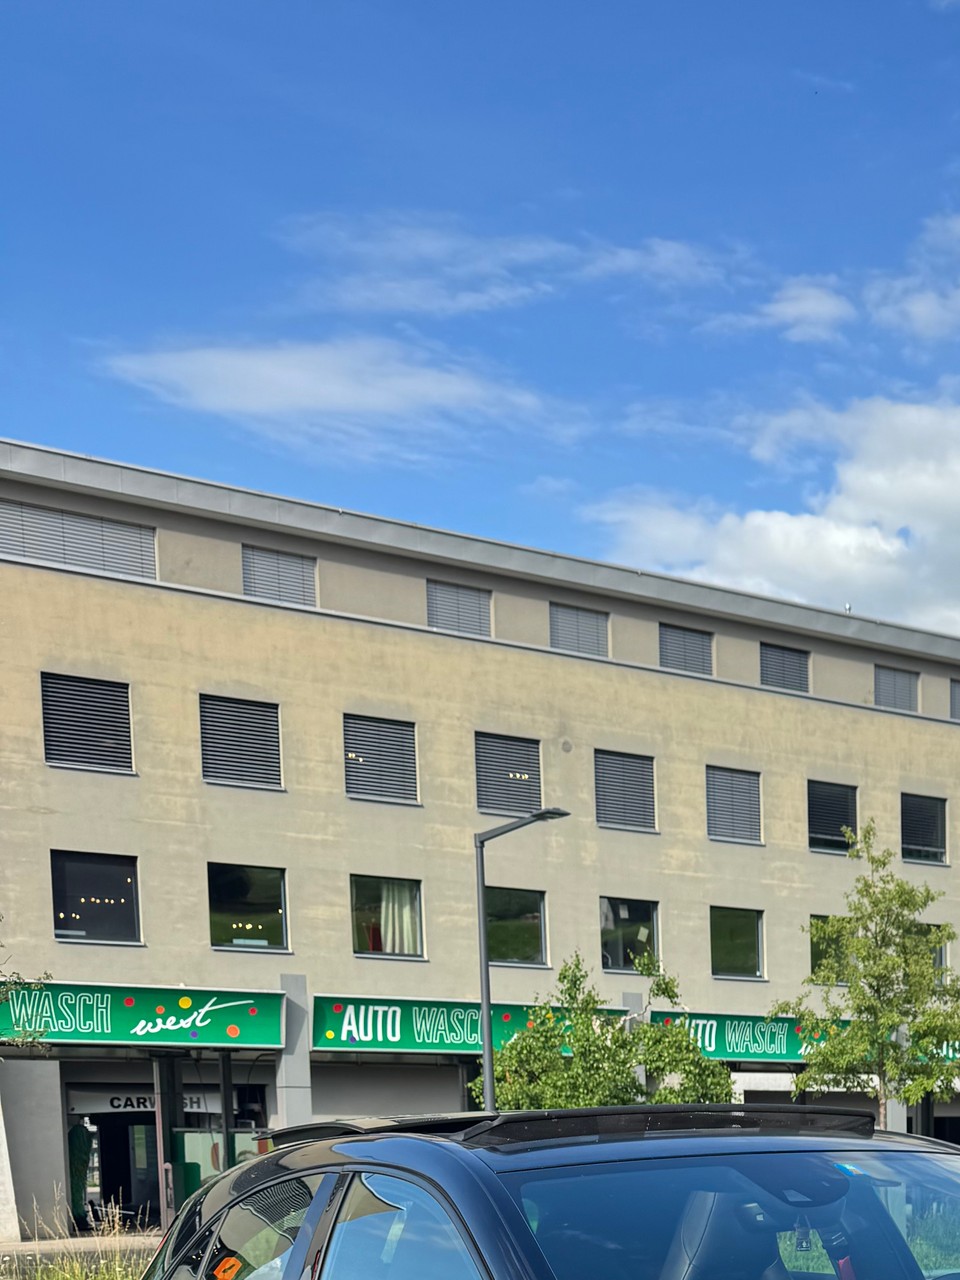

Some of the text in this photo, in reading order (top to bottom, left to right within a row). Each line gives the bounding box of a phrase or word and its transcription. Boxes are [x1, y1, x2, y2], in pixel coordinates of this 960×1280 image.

[9, 990, 255, 1036] WASCH west
[341, 1004, 402, 1042] AUTO
[725, 1020, 788, 1054] WASCH
